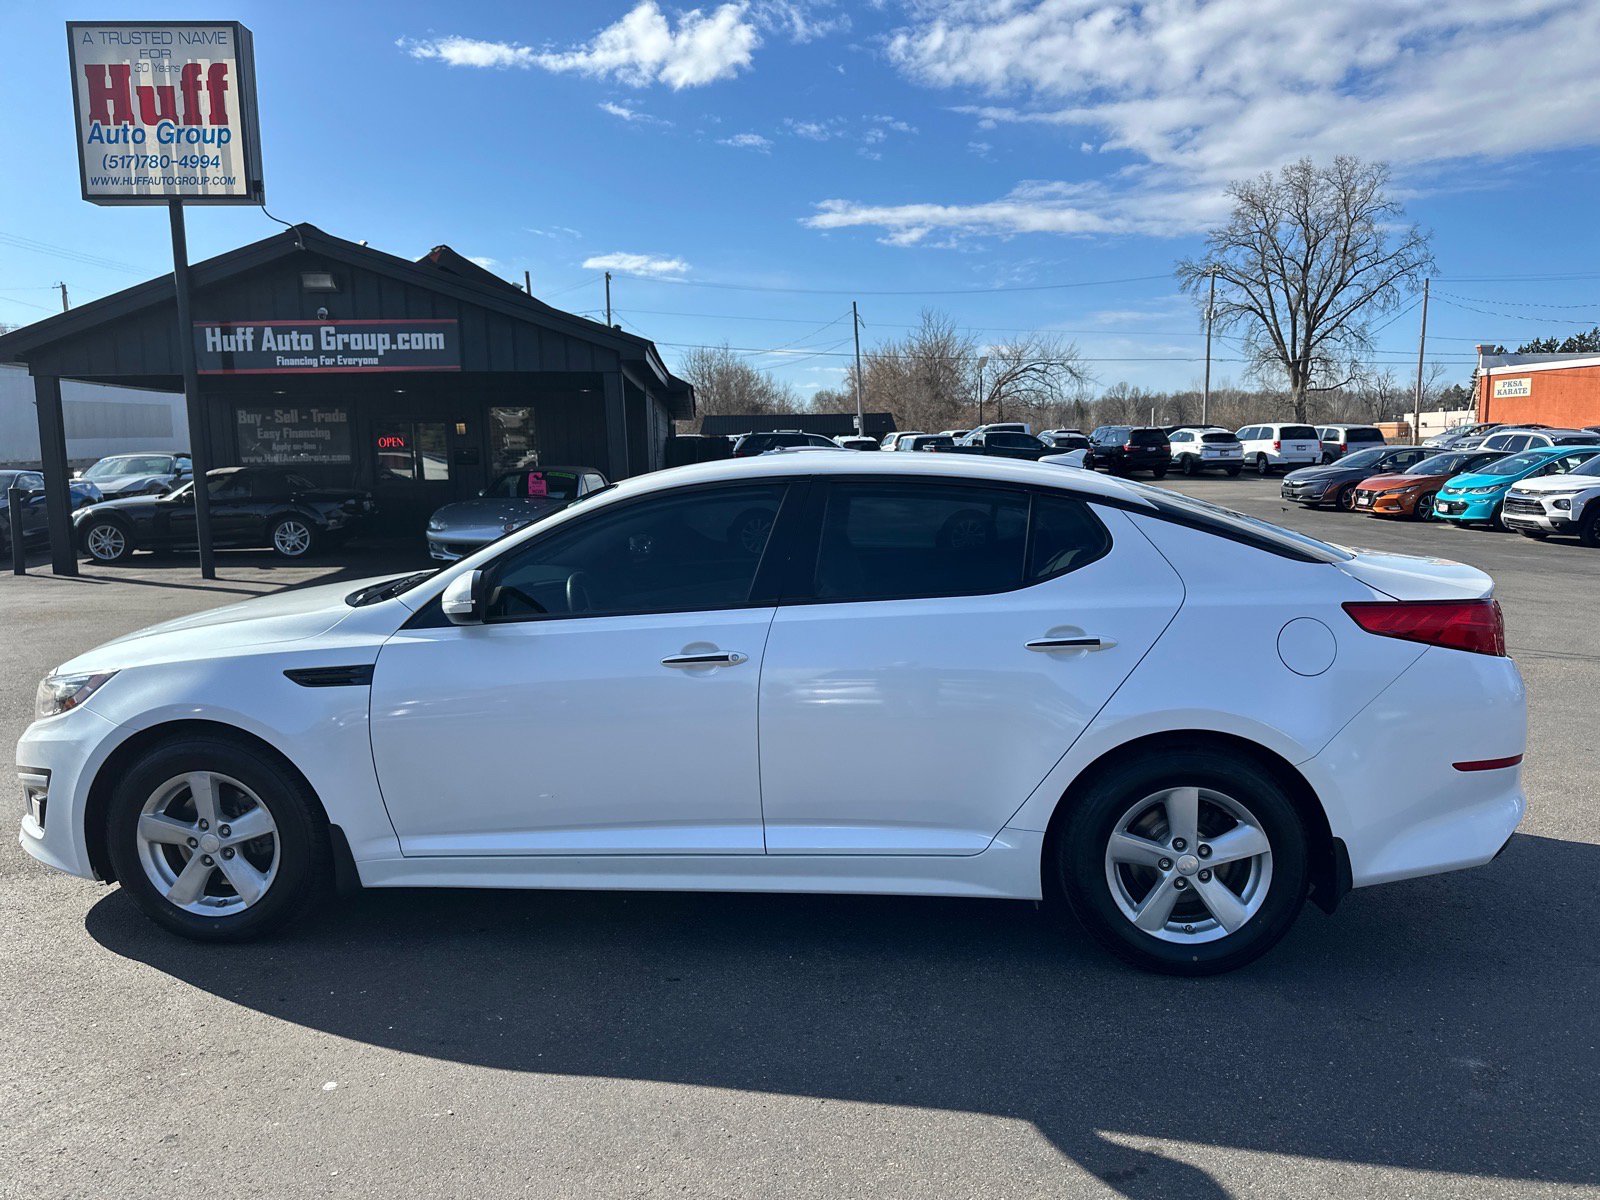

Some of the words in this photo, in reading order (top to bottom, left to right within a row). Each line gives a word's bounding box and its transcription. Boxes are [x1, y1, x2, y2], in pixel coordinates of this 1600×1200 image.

[82, 31, 94, 45] A
[99, 31, 173, 45] TRUSTED
[178, 31, 227, 45] NAME
[139, 48, 172, 59] FOR
[134, 62, 150, 73] 30
[154, 62, 180, 73] Years
[84, 63, 229, 126] Huff
[87, 122, 146, 144] Auto
[156, 122, 232, 149] Group
[102, 154, 221, 170] (517)780-4994
[90, 176, 236, 186] WWW.HUFFAUTOGROUP.COM
[205, 327, 254, 351] Huff
[262, 327, 314, 351] Auto
[320, 326, 445, 356] Group.com
[276, 356, 318, 368] Financing
[320, 356, 336, 366] For
[337, 356, 379, 367] Everyone
[1502, 380, 1522, 388] PKSA
[1496, 387, 1528, 395] KARATE
[238, 409, 262, 426] Buy
[274, 409, 298, 424] Sell
[310, 409, 347, 423] Trade
[257, 428, 280, 440] Easy
[283, 428, 331, 440] Financing
[272, 443, 292, 452] Apply
[378, 436, 405, 448] OPEN
